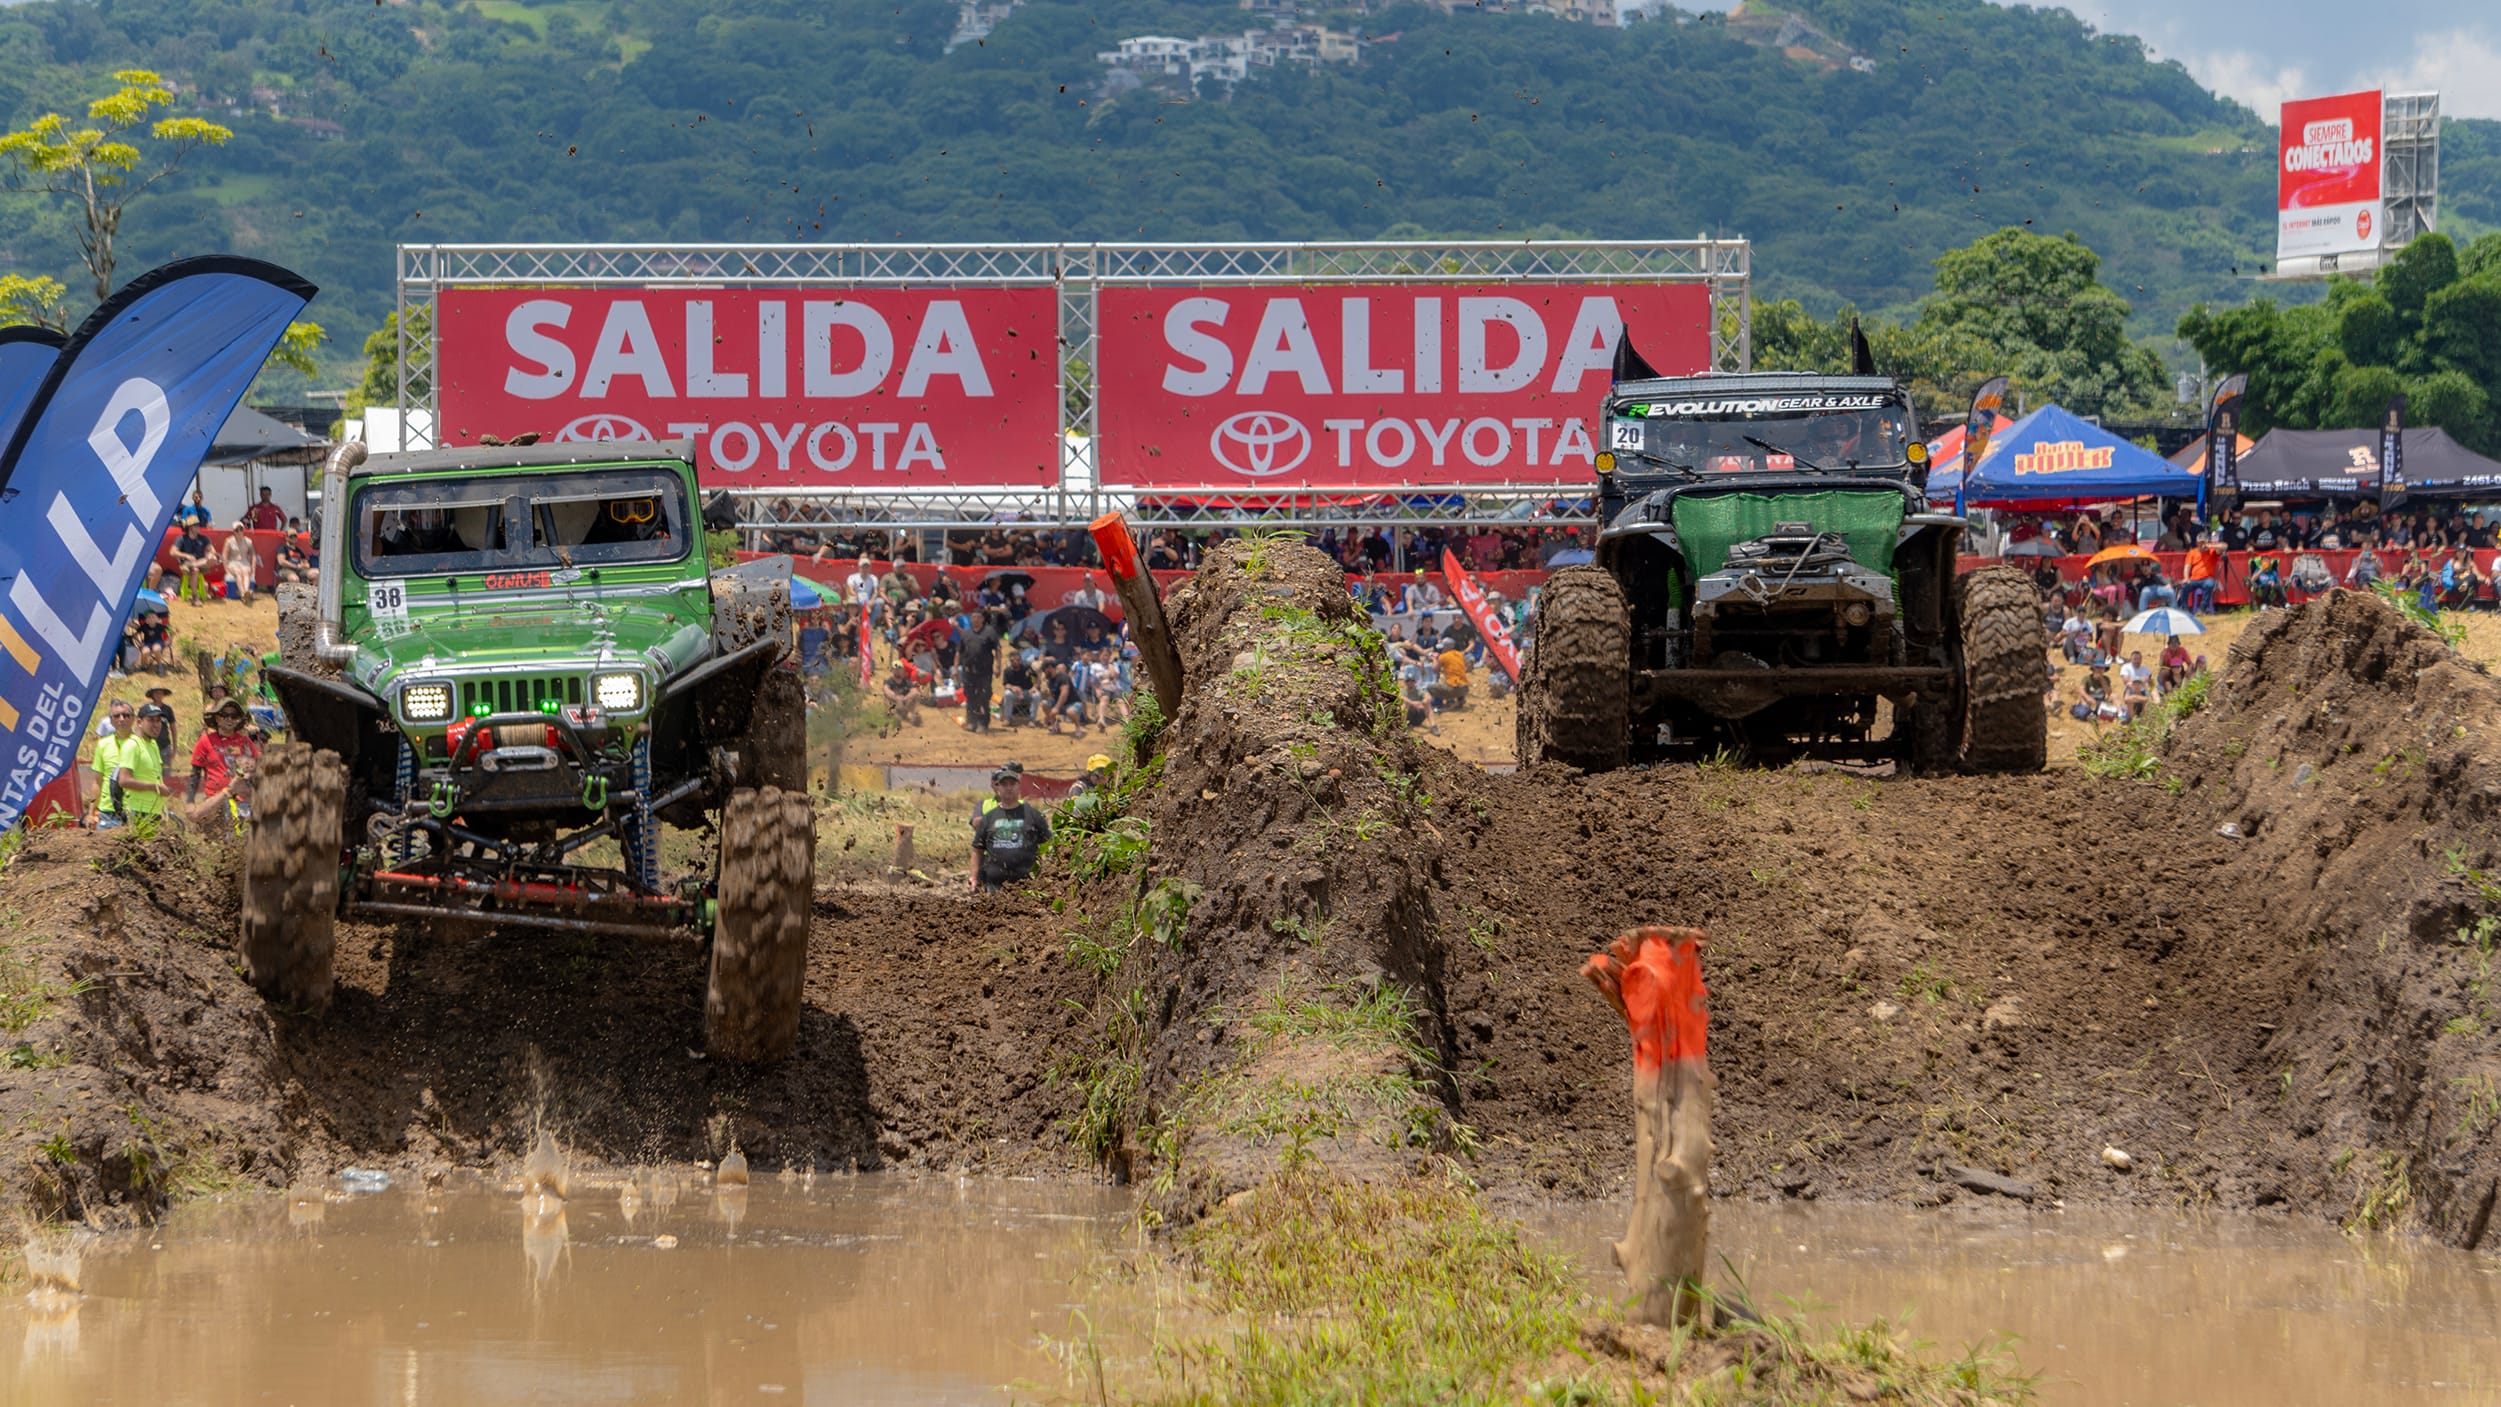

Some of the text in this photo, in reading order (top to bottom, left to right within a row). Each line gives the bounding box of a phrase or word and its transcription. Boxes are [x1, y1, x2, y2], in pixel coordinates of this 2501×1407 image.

[2308, 123, 2347, 143] SIEMPRE
[2284, 136, 2373, 172] CONECTADOS
[504, 299, 994, 400] SALIDA
[1162, 296, 1626, 397] SALIDA
[1628, 396, 1885, 419] REVOLUTION GEAR & AXLE
[1330, 417, 1597, 468] TOYOTA
[1617, 427, 1640, 444] 20
[2240, 480, 2272, 491] Pizza
[2274, 478, 2310, 491] Ranch
[374, 588, 401, 609] 38
[26, 681, 64, 741] DEL
